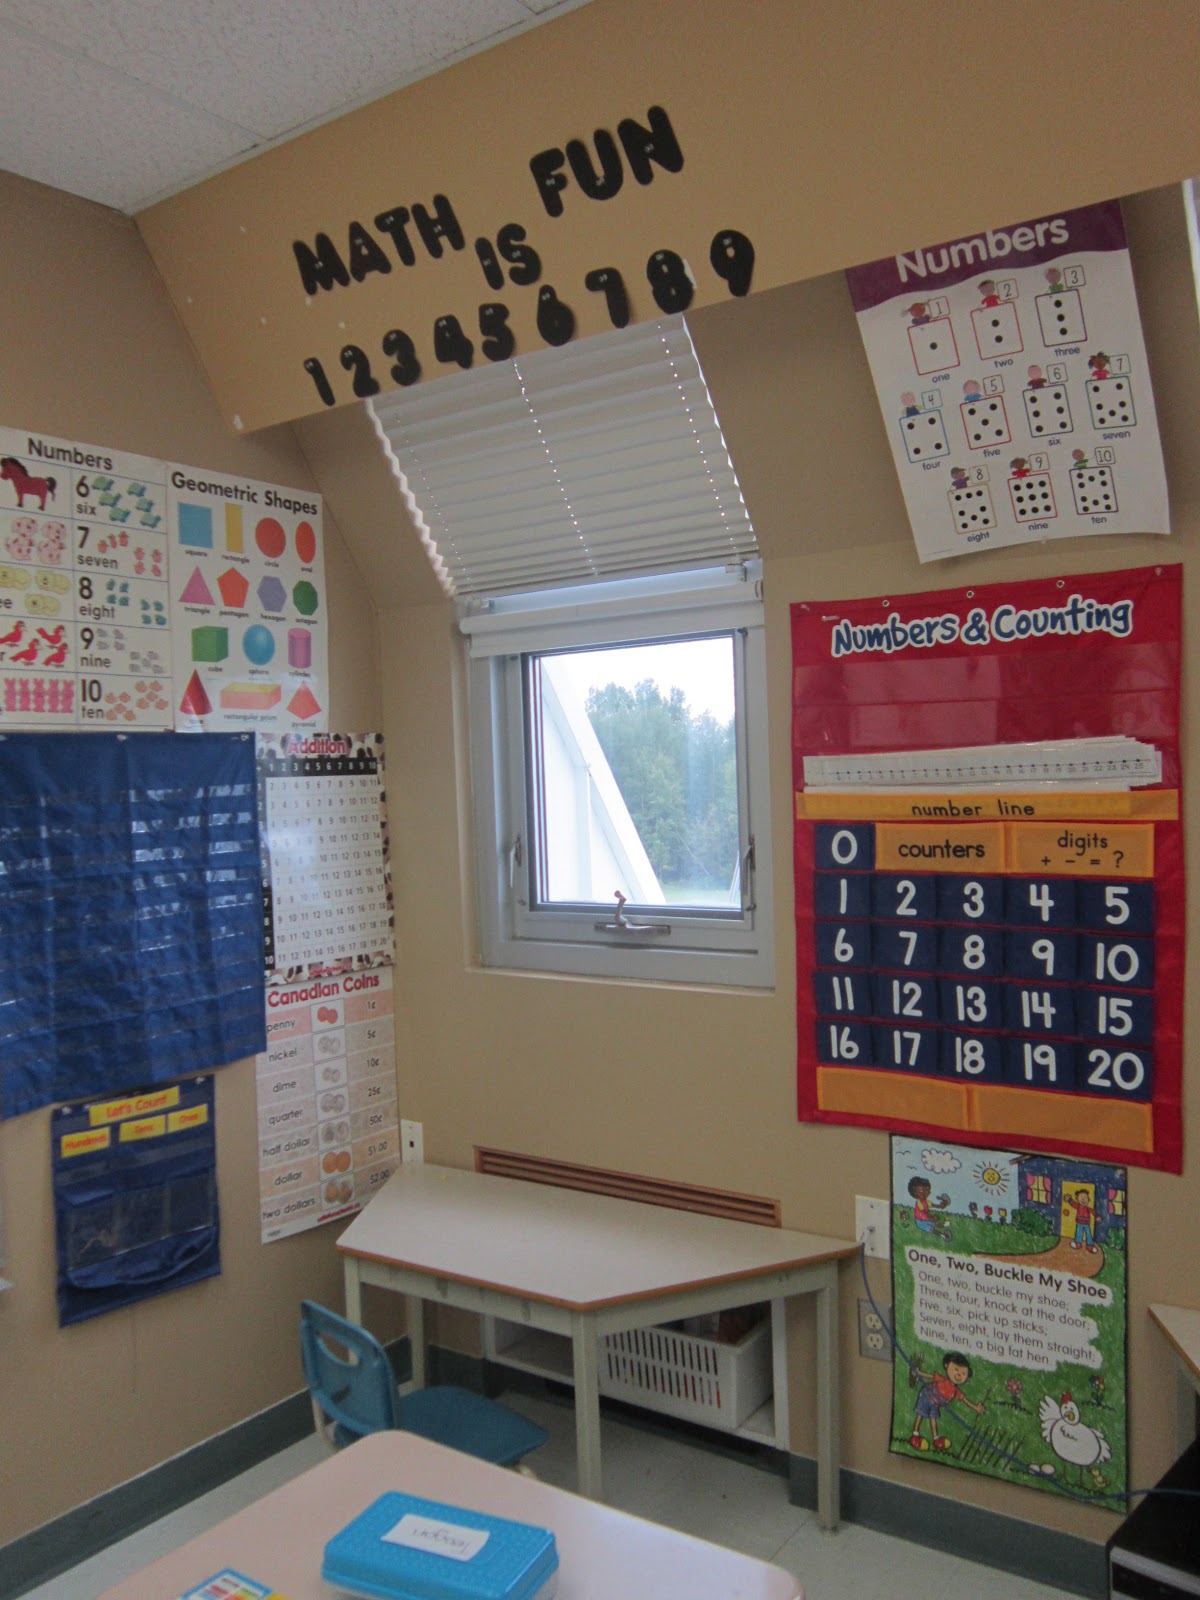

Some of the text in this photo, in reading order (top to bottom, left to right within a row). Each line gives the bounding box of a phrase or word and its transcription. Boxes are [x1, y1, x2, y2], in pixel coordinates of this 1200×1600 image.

[292, 105, 684, 295] MATH IS FUN
[895, 218, 1070, 283] Numbers
[1070, 271, 1079, 285] 3
[1003, 283, 1013, 298] 2
[935, 303, 944, 315] 1
[304, 229, 755, 406] 1 2 3 4 5 6 7 8 9
[1054, 345, 1081, 358] three
[994, 357, 1014, 369] two
[1116, 358, 1124, 371] 7
[931, 372, 950, 383] one
[1053, 367, 1062, 380] 6
[989, 379, 998, 392] 5
[927, 394, 935, 406] 4
[1048, 436, 1061, 447] six
[1102, 430, 1131, 441] seven
[28, 438, 113, 470] Numbers
[983, 447, 1000, 458] five
[1097, 450, 1112, 463] 10
[922, 460, 941, 471] four
[1035, 456, 1043, 469] 9
[975, 467, 984, 480] 8
[75, 475, 90, 498] 6
[171, 471, 318, 515] Geometric Shapes
[76, 503, 97, 517] six
[1028, 521, 1048, 531] nine
[1091, 515, 1107, 524] ten
[77, 526, 90, 549] 7
[966, 531, 990, 543] eight
[77, 554, 118, 572] seven
[78, 576, 93, 600] 8
[79, 604, 116, 620] eight
[832, 594, 1133, 657] Numbers & Counting
[80, 627, 95, 650] 9
[80, 654, 111, 668] nine
[81, 679, 102, 703] 10
[81, 706, 105, 720] ten
[287, 738, 346, 755] Addition
[911, 801, 1035, 817] number line
[831, 830, 858, 865] 0
[898, 840, 985, 859] counters
[1058, 830, 1108, 857] digits
[840, 879, 1129, 925] 1 2 3 4 5
[834, 928, 1139, 982] 6 7 8 9 10
[267, 974, 379, 1008] Canadian Coins
[833, 977, 1133, 1036] 11 12 13 14 15
[266, 1019, 296, 1034] penny
[268, 1048, 297, 1062] nickel
[830, 1025, 1144, 1090] 16 17 18 19 20
[272, 1081, 297, 1093] dime
[106, 1103, 132, 1118] Let's
[268, 1108, 303, 1125] quarter
[262, 1143, 282, 1157] half
[283, 1138, 310, 1152] dollar
[273, 1171, 302, 1186] dollar
[262, 1208, 281, 1220] two
[283, 1198, 315, 1214] dollars
[908, 1249, 1107, 1299] One, Two, Buckle My Shoe
[918, 1271, 1069, 1311] One, two, buckle my shoe;
[919, 1284, 951, 1302] Three,
[956, 1291, 980, 1307] four,
[984, 1297, 1018, 1314] knock
[1021, 1307, 1033, 1317] at
[1037, 1308, 1055, 1322] the
[946, 1305, 963, 1318] six,
[968, 1310, 990, 1323] pick
[994, 1317, 1009, 1327] up
[920, 1312, 955, 1330] Seven,
[993, 1327, 1009, 1342] lay
[1013, 1333, 1043, 1348] them
[920, 1325, 948, 1342] Nine,
[951, 1333, 971, 1349] ten,
[976, 1341, 983, 1349] a
[986, 1341, 1004, 1357] big
[1008, 1345, 1023, 1358] fat
